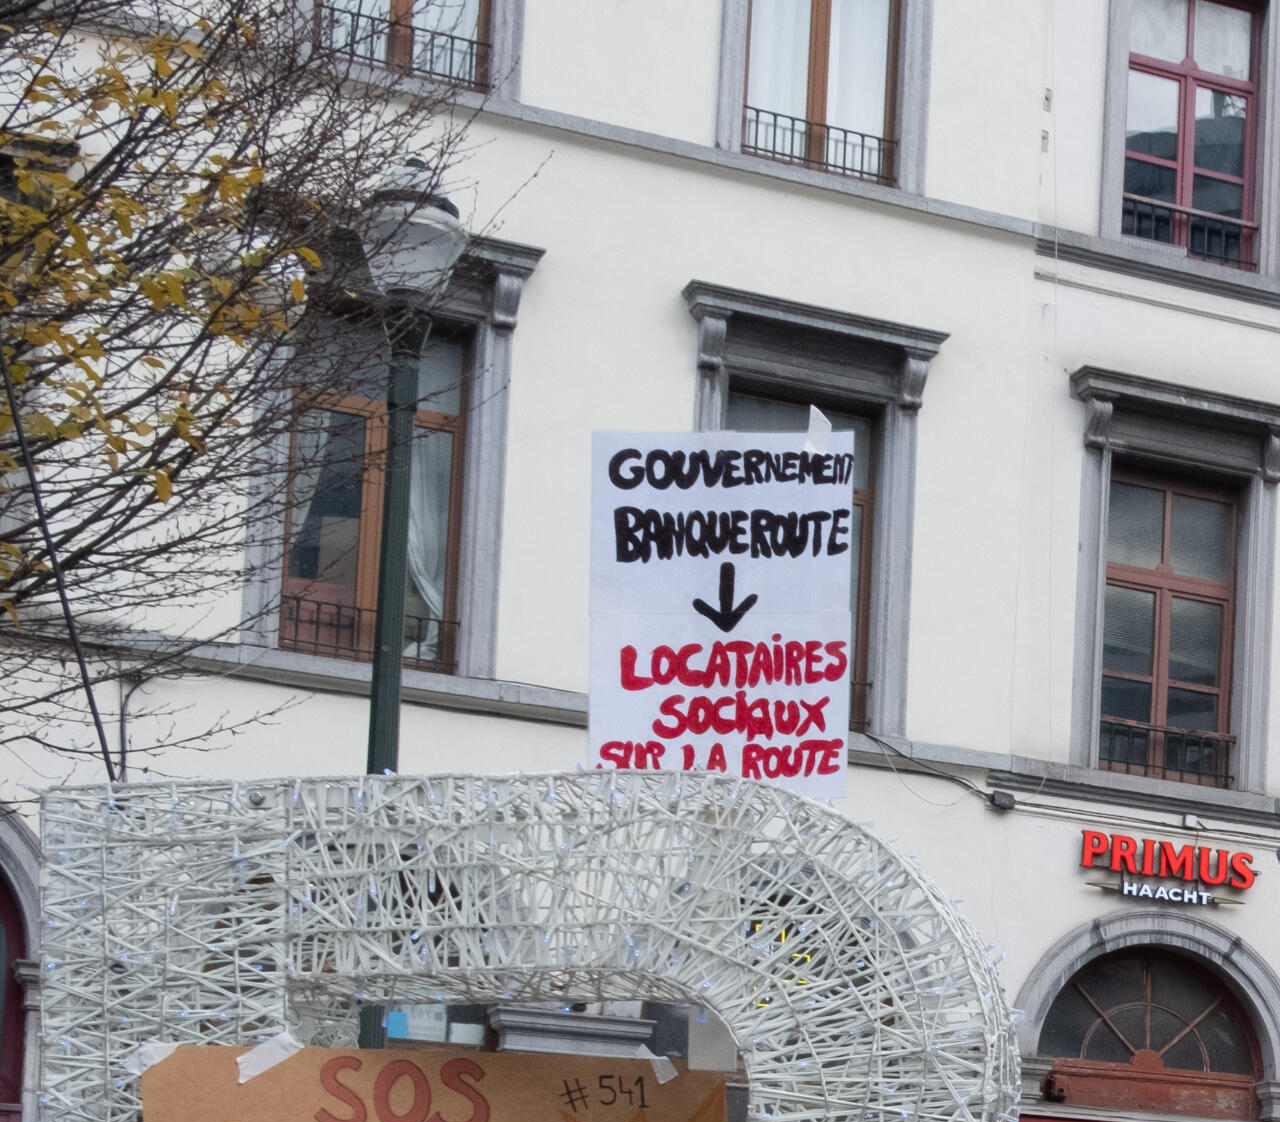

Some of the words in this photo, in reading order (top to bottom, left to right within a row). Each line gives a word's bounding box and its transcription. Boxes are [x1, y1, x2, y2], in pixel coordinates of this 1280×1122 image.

[608, 448, 853, 489] GOUVERNEMENT
[614, 506, 850, 563] BANQUEROUTE
[596, 740, 666, 770] SUR
[741, 738, 844, 780] ROUTE
[1081, 830, 1255, 890] PRIMUS
[1123, 882, 1211, 904] HAACHT
